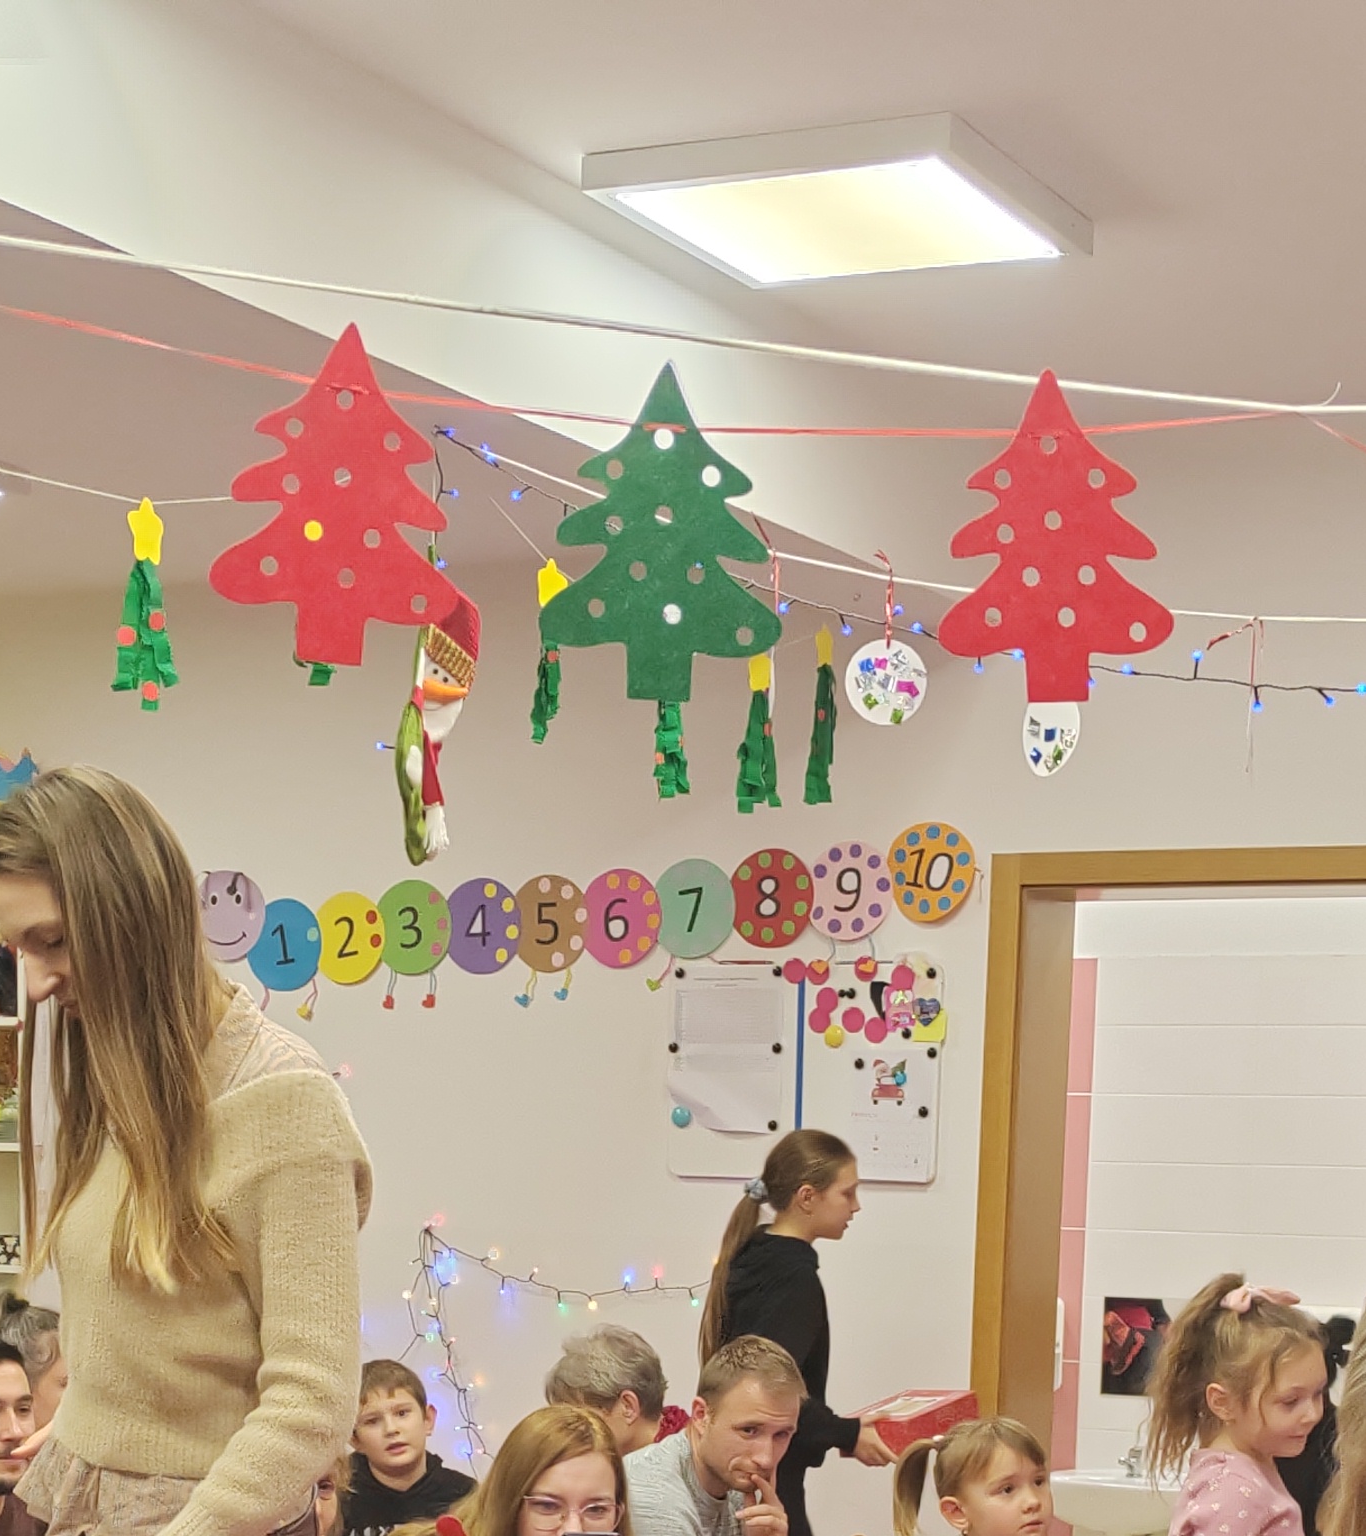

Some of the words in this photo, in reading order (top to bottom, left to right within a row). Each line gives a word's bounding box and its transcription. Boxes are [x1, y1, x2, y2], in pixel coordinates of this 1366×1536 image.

[271, 923, 295, 965] 1
[334, 916, 359, 958] 2
[398, 906, 422, 949] 3
[465, 904, 491, 947] 4
[535, 902, 559, 945] 5
[604, 898, 629, 942] 6
[678, 886, 703, 932] 7
[756, 875, 780, 918] 8
[834, 867, 861, 912] 9
[905, 848, 954, 891] 10
